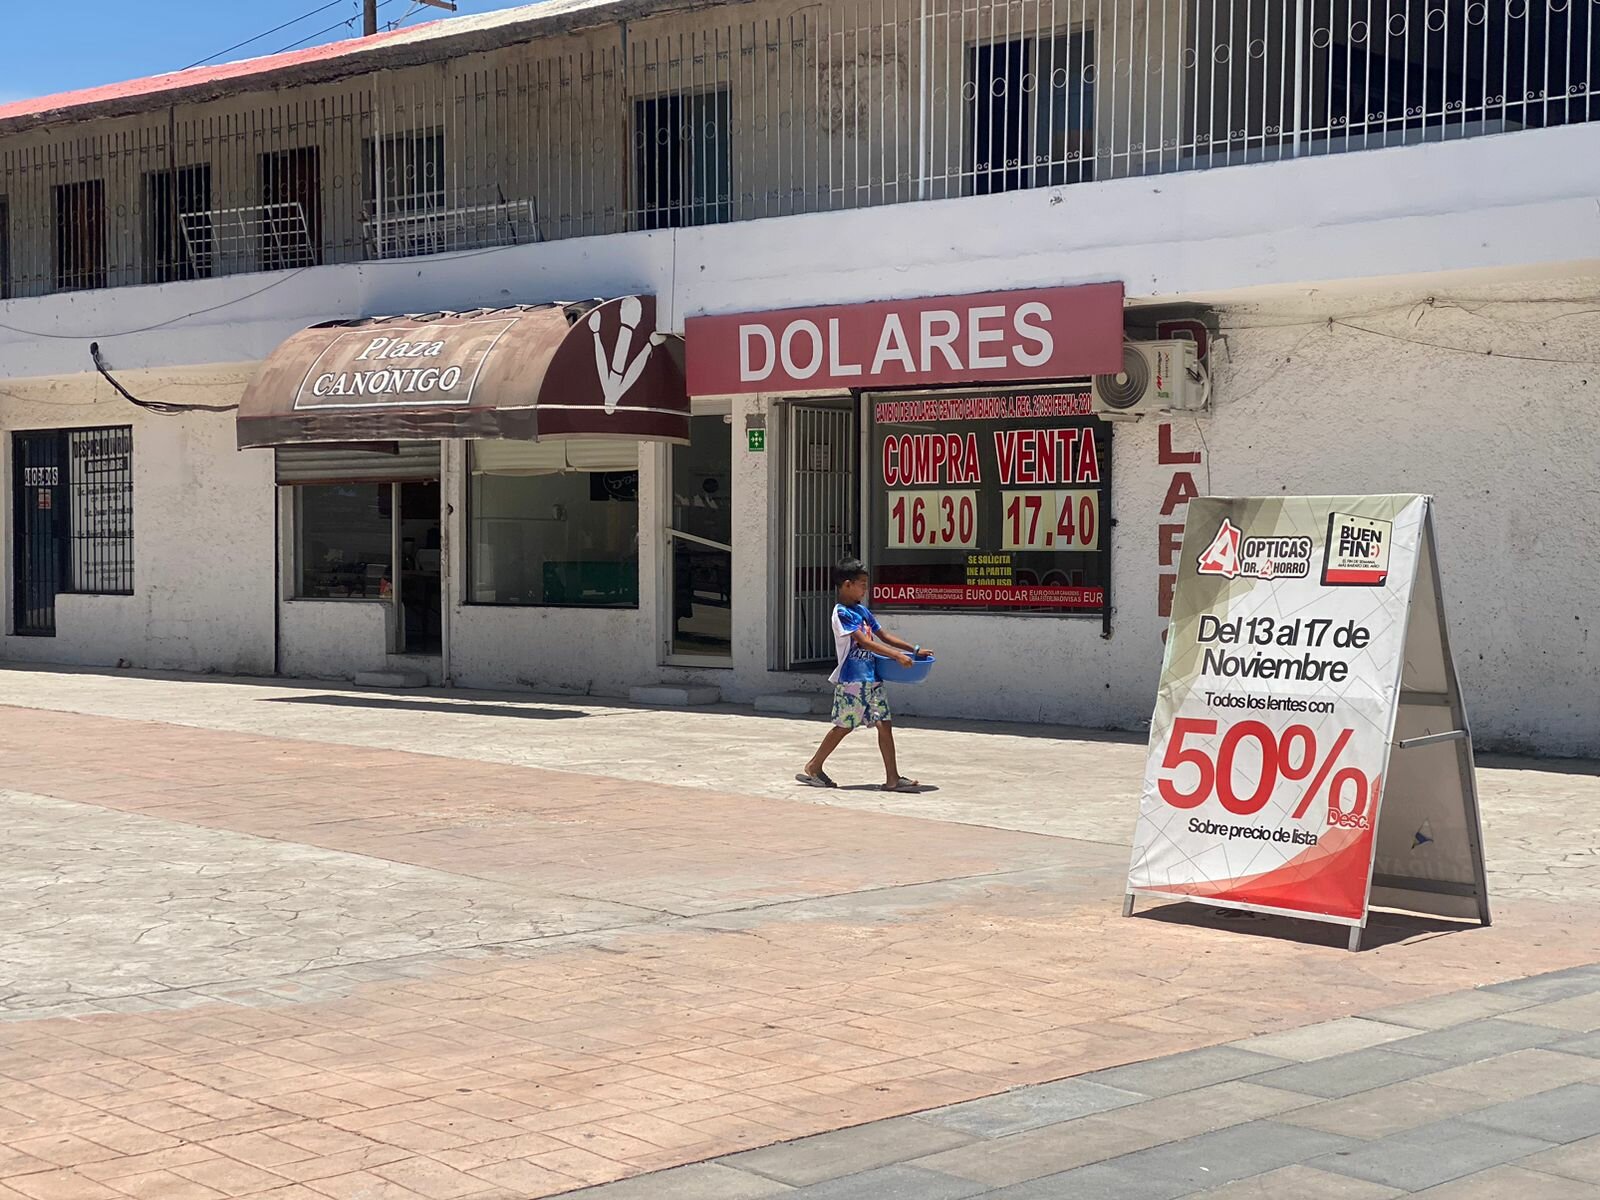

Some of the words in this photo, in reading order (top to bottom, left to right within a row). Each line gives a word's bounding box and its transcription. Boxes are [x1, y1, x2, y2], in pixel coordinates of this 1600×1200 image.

[355, 337, 445, 361] Plaza
[739, 301, 1054, 383] DOLARES
[883, 432, 981, 487] COMPRA
[994, 427, 1100, 485] VENTA
[892, 495, 974, 544] 16.30
[1007, 495, 1095, 546] 17.40
[1341, 525, 1382, 543] BUEN
[967, 555, 977, 564] SE
[1246, 541, 1308, 558] OPTICAS
[979, 567, 985, 576] A
[986, 567, 1012, 576] PARTIR
[1243, 561, 1260, 573] DR.
[1260, 559, 1305, 577] AHORRO
[873, 586, 915, 600] DOLAR
[966, 588, 992, 601] EURO
[995, 589, 1028, 601] DOLAR
[1197, 615, 1242, 644] Del
[1246, 617, 1275, 645] 13
[1275, 618, 1301, 647] al
[1304, 619, 1333, 648] 17
[1333, 620, 1370, 649] de
[1201, 648, 1348, 683] Noviembre
[1205, 692, 1245, 709] Todos
[1246, 695, 1265, 710] los
[1266, 696, 1307, 712] lentes
[1308, 701, 1334, 714] con
[1157, 717, 1369, 819] 50%
[1326, 806, 1370, 829] Desc.
[1188, 818, 1229, 838] Sobre
[1229, 823, 1271, 841] precio
[1272, 826, 1291, 843] de
[1291, 827, 1318, 846] lista
